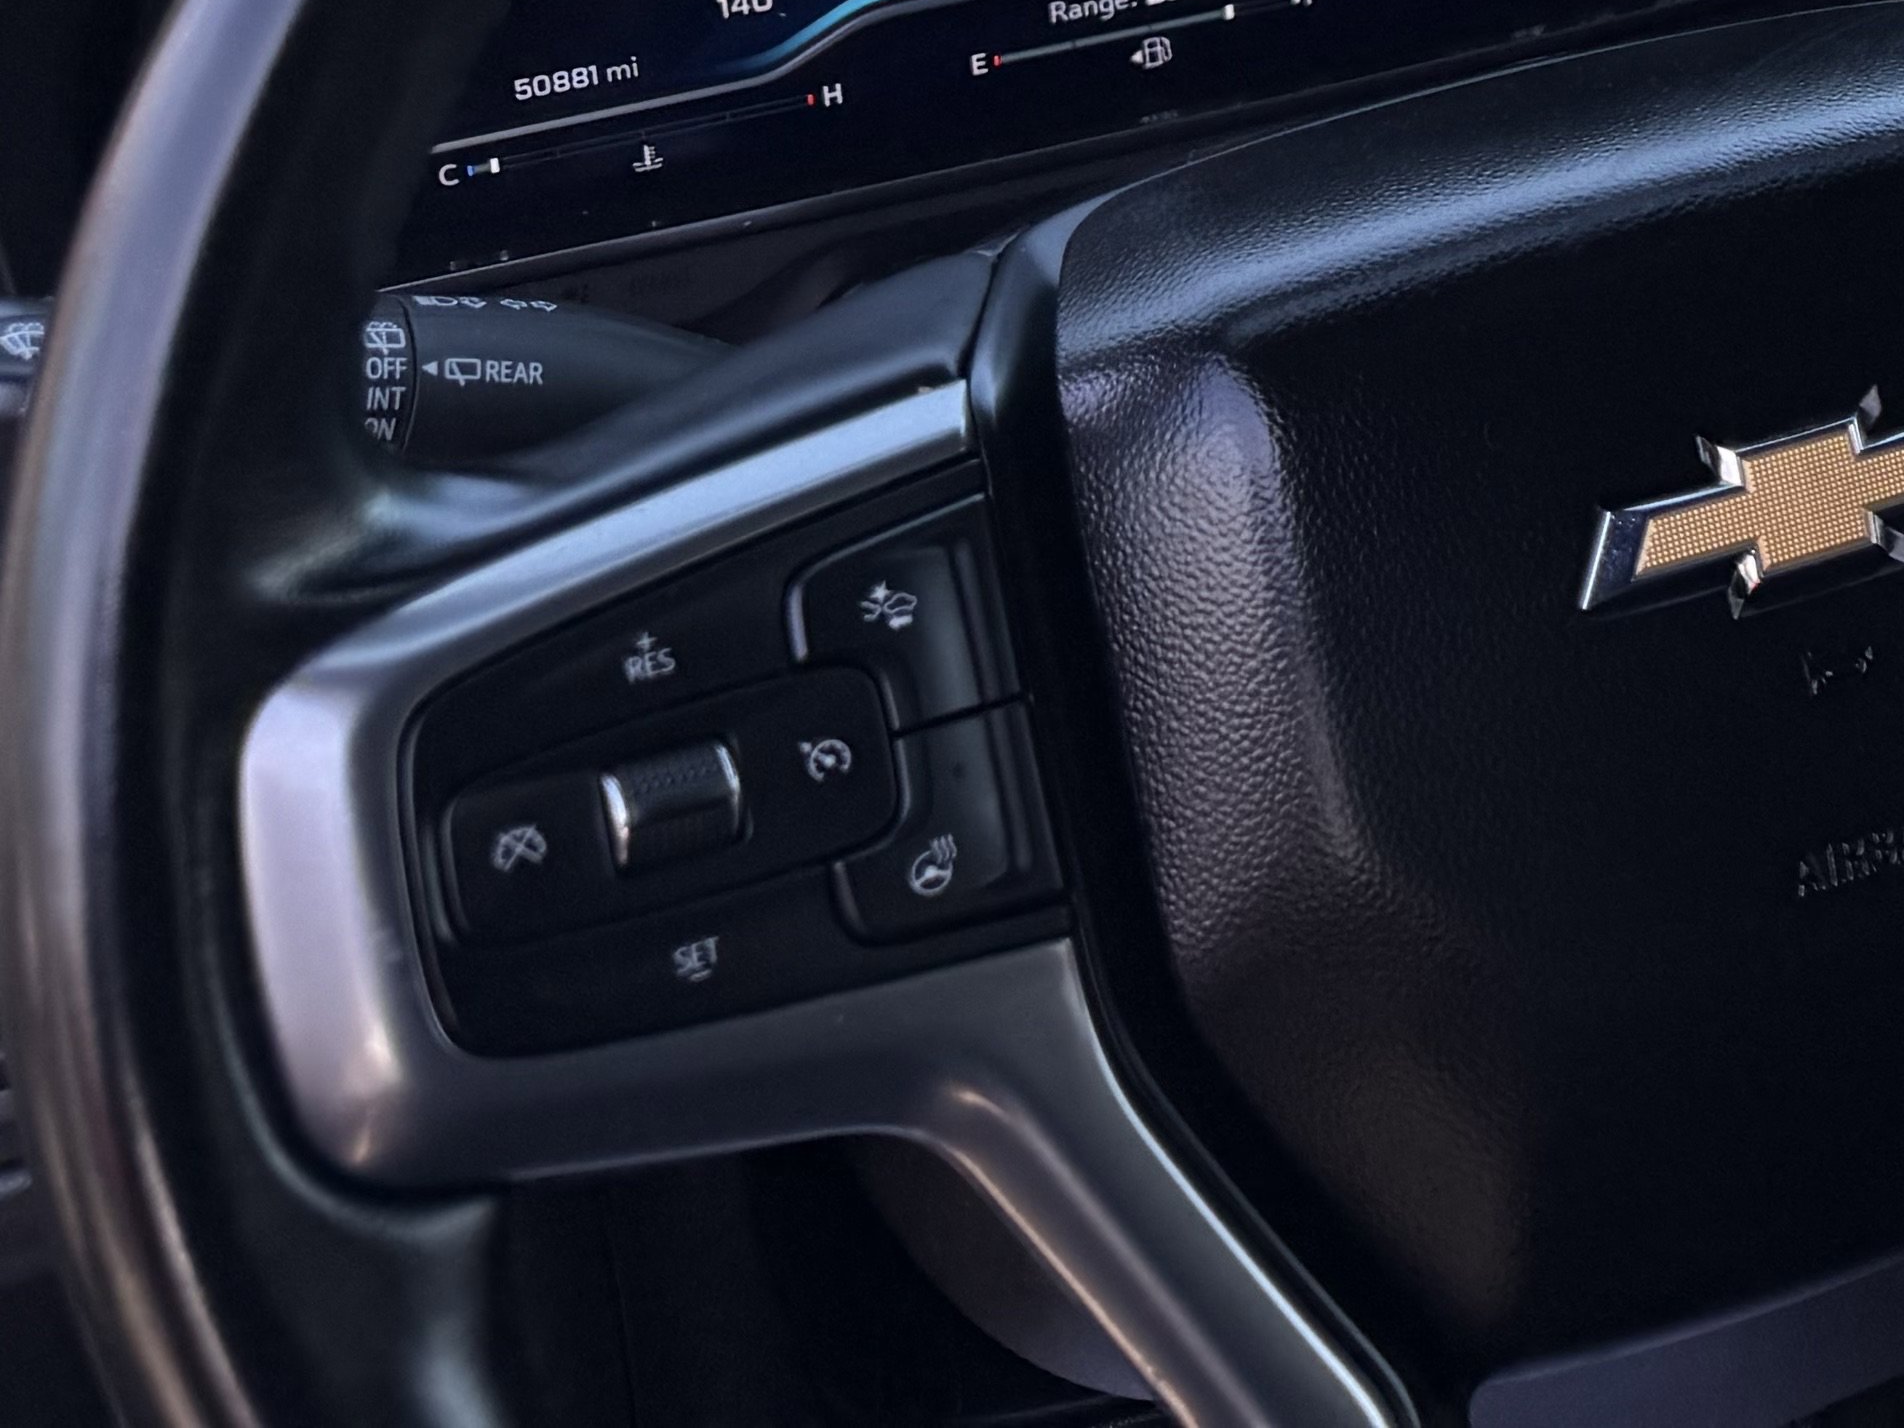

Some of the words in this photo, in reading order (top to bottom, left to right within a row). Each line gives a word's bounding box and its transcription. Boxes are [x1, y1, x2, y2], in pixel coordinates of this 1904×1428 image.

[971, 52, 989, 76] E
[514, 64, 599, 101] 50881
[606, 55, 639, 83] mi
[822, 82, 843, 107] H
[438, 163, 460, 186] C
[365, 356, 408, 380] OFF
[486, 360, 544, 385] REAR
[366, 386, 407, 411] INT
[624, 647, 676, 683] RES
[673, 936, 718, 972] SET
